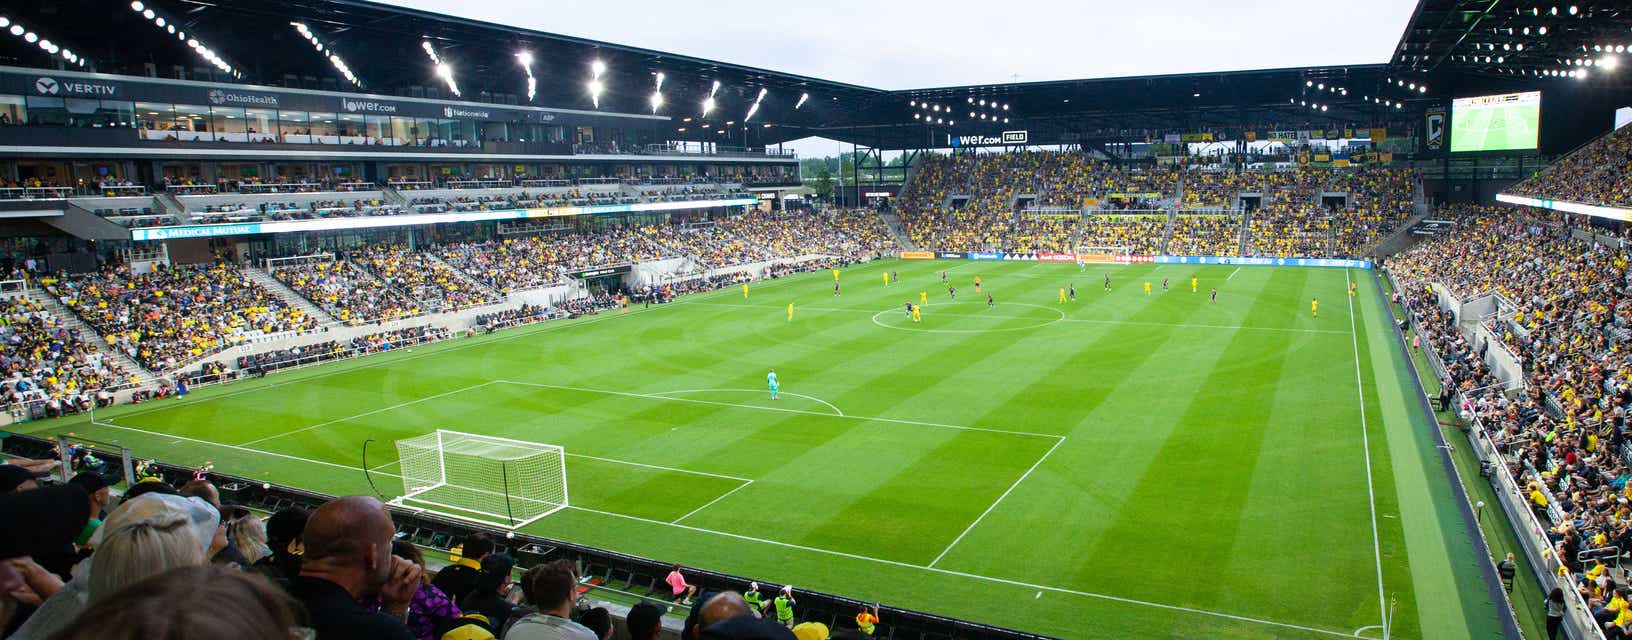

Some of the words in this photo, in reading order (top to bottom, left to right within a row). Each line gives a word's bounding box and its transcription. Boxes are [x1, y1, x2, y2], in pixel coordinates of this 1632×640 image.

[64, 82, 115, 95] VERTIV
[226, 93, 279, 105] OhioHealth
[453, 108, 488, 119] Nationwide
[1005, 133, 1024, 141] FIELD
[168, 227, 211, 238] MEDICAL
[213, 225, 250, 235] MUTUAL
